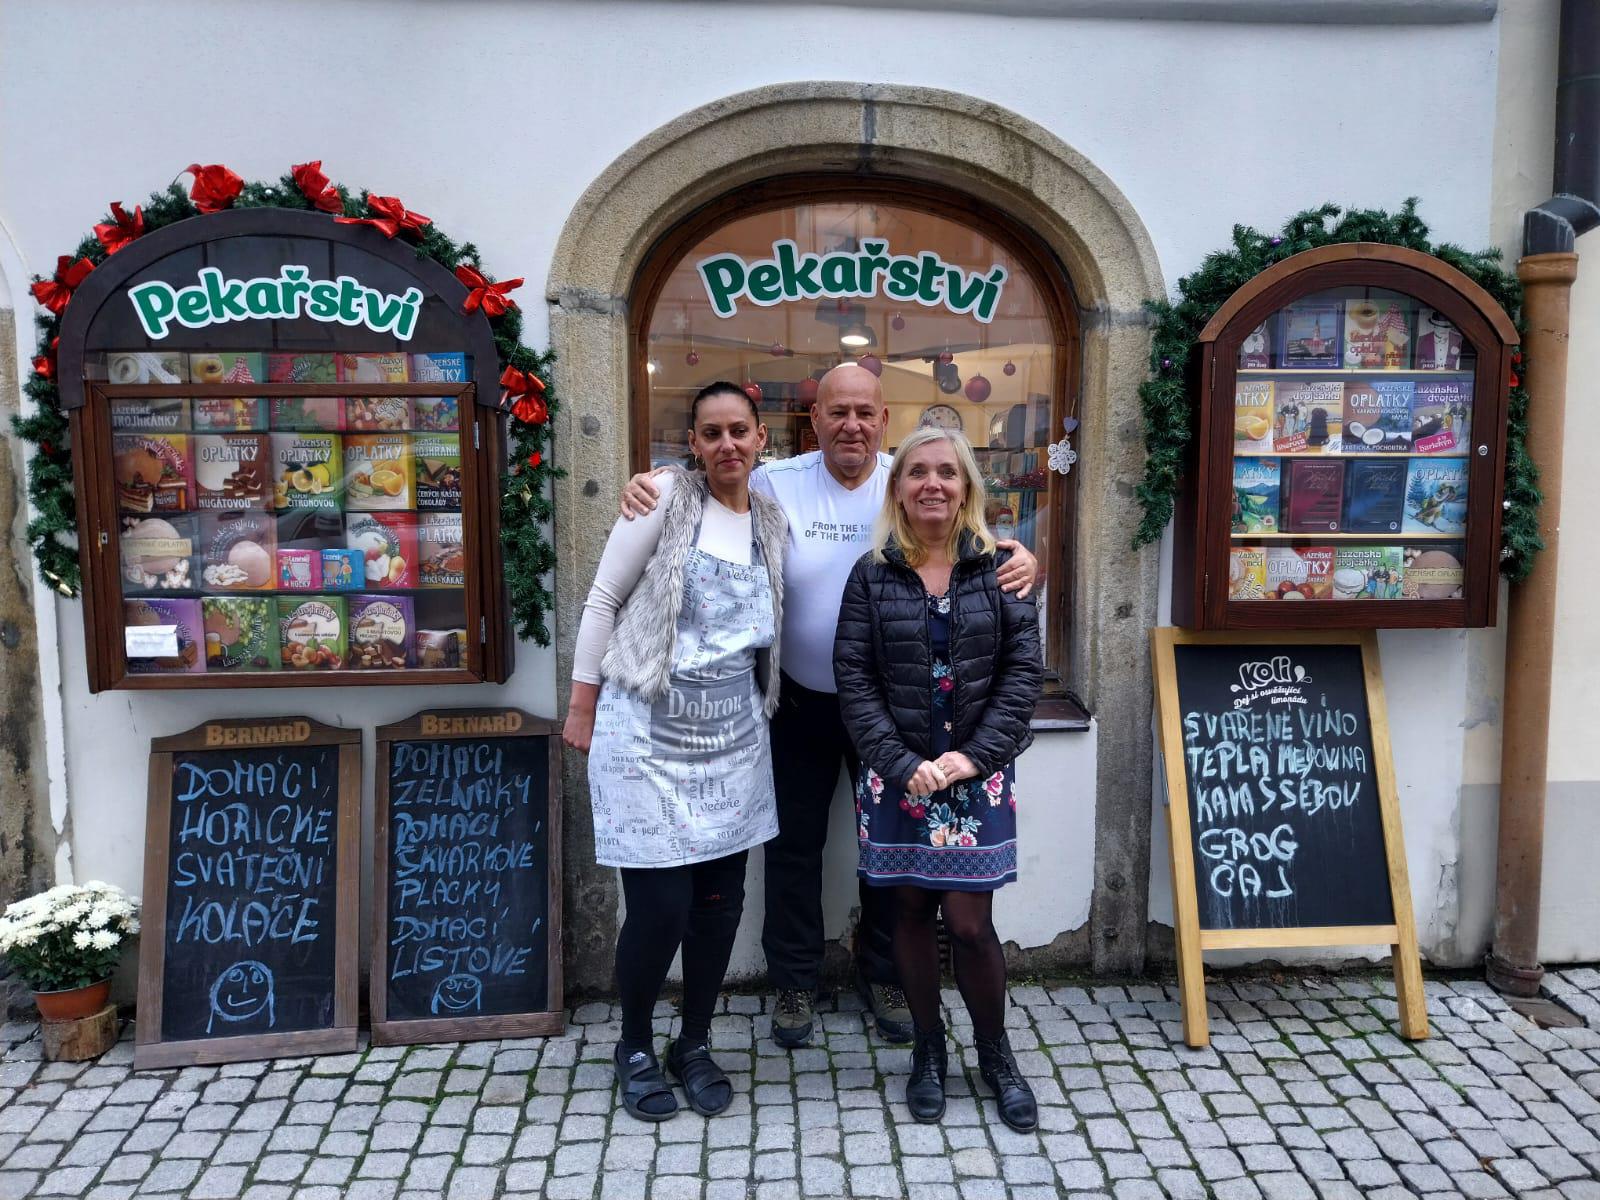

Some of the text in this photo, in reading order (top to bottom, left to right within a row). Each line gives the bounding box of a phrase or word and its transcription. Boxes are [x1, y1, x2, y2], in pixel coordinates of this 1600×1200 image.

[697, 239, 1008, 323] Pekařství
[128, 265, 424, 341] Pekařství
[1350, 394, 1410, 408] OPLATKY
[201, 446, 258, 463] OPLATKY
[279, 448, 332, 464] OPLATKY
[348, 446, 402, 462] OPLATKY
[812, 521, 837, 531] FROM
[840, 524, 858, 532] THE
[805, 530, 818, 538] OF
[821, 531, 839, 541] THE
[1268, 560, 1331, 576] OPLATKY
[667, 688, 742, 720] Dobrou
[1234, 695, 1250, 709] Dej
[1251, 691, 1259, 700] si
[1271, 696, 1308, 704] limonádu
[421, 711, 522, 735] BERNARD
[206, 721, 311, 746] BERNARD
[700, 798, 741, 812] večeře
[1199, 824, 1299, 861] GROG
[1210, 860, 1293, 898] ČAJ
[394, 878, 501, 909] PLACKY
